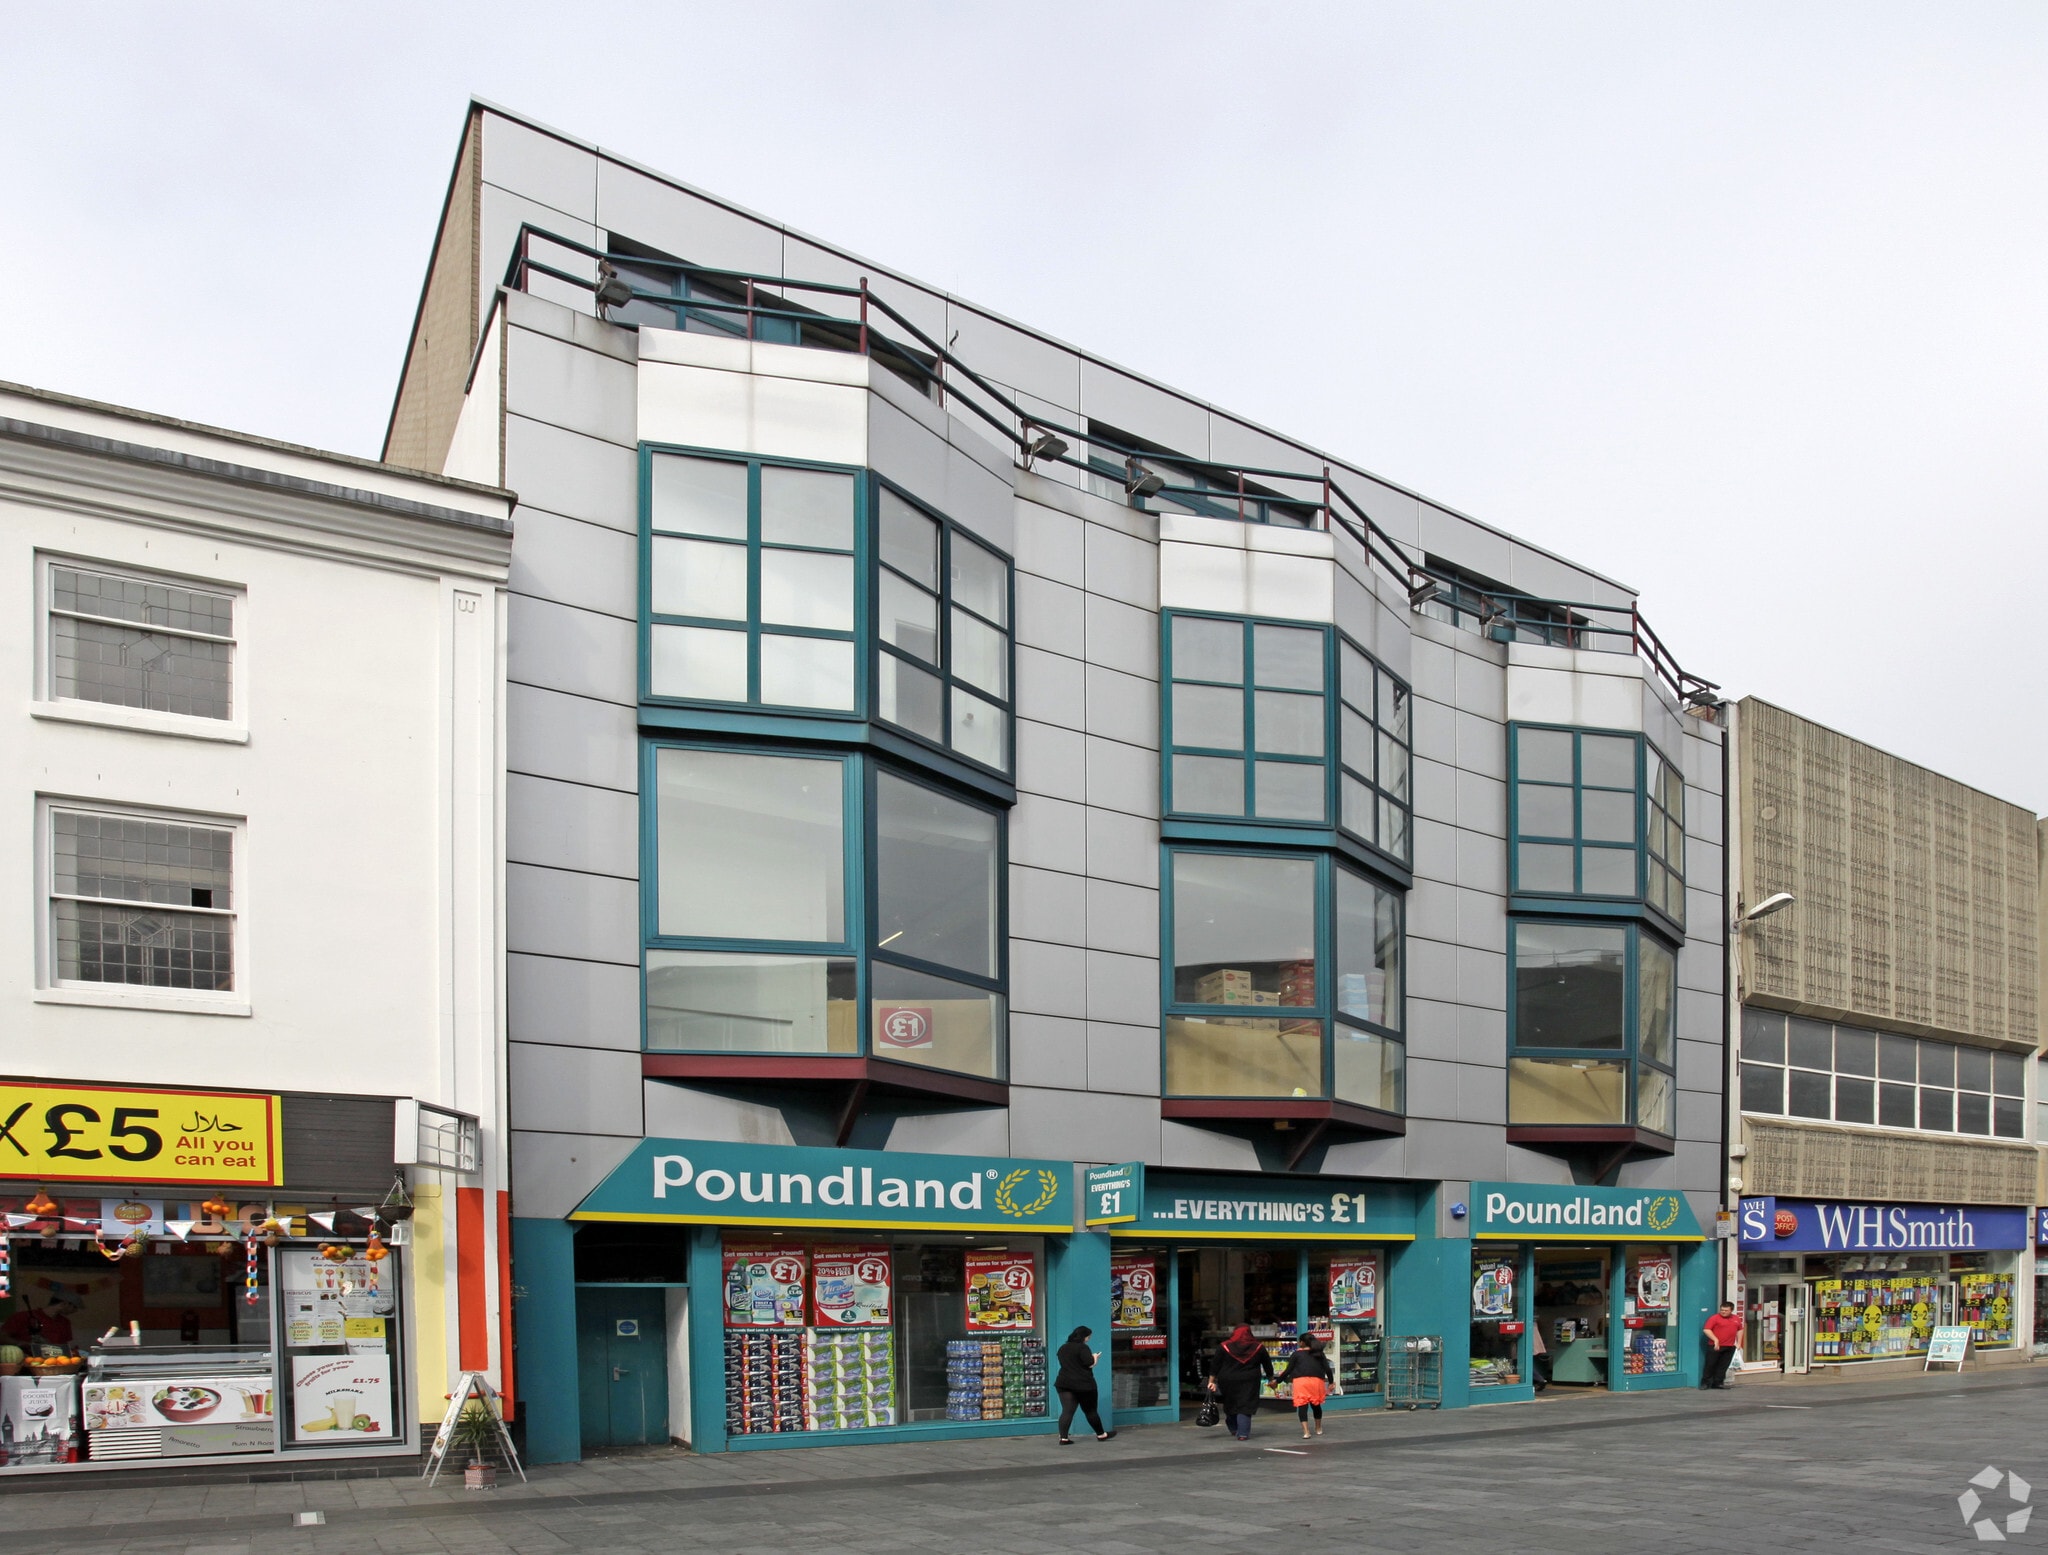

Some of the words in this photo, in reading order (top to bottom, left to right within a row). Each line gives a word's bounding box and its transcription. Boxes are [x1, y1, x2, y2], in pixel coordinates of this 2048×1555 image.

[892, 1018, 918, 1037] £1
[181, 1111, 243, 1133] حلال
[44, 1103, 163, 1161] £5
[176, 1136, 205, 1149] All
[213, 1140, 254, 1153] you
[174, 1156, 214, 1166] can
[223, 1156, 256, 1167] eat
[654, 1154, 983, 1210] Poundland
[1090, 1169, 1124, 1180] Poundland
[1091, 1180, 1131, 1193] EVERYTHING'S
[1101, 1192, 1120, 1214] £1
[1331, 1194, 1366, 1224] £1
[1487, 1193, 1642, 1226] Poundland
[1744, 1201, 1765, 1210] WH
[1743, 1210, 1766, 1240] S
[1815, 1204, 1975, 1249] WHSmith
[774, 1263, 797, 1280] £1
[817, 1267, 835, 1275] 20%
[861, 1264, 883, 1281] £1
[1007, 1271, 1028, 1287] £1
[1358, 1270, 1373, 1284] £1
[1657, 1267, 1668, 1278] £1
[1132, 1274, 1150, 1288] £1
[1936, 1329, 1966, 1338] kobo
[296, 1370, 316, 1388] Choose
[316, 1363, 334, 1373] your
[168, 1436, 200, 1448] Amaretto
